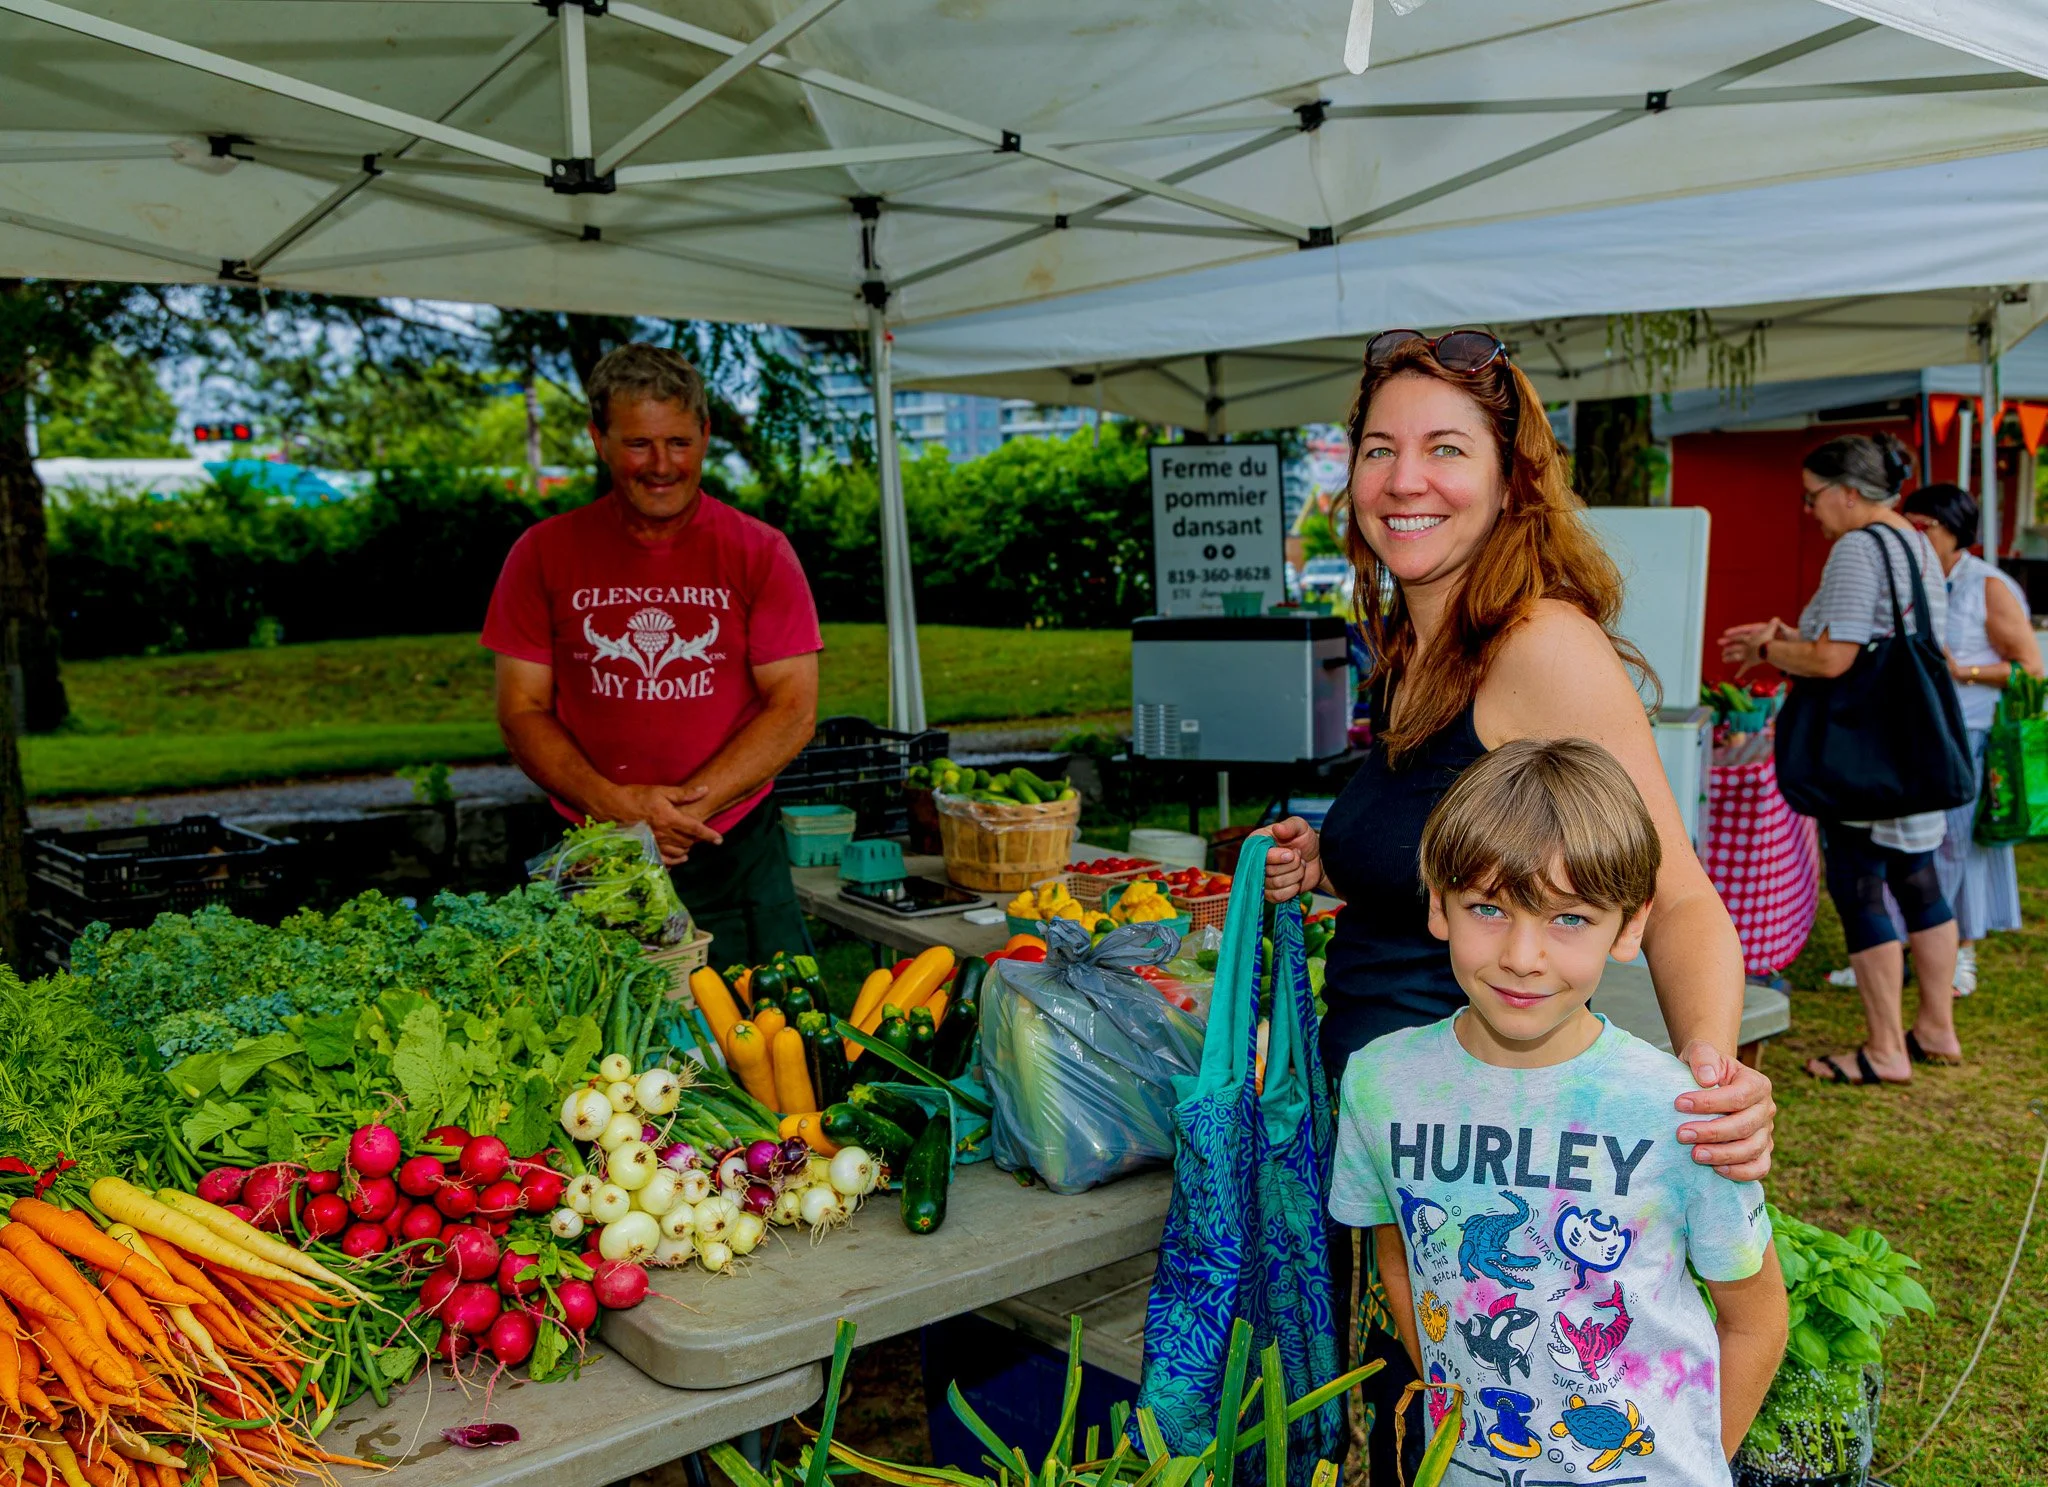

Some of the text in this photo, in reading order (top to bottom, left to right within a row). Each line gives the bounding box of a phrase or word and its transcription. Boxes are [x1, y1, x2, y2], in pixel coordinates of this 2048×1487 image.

[1161, 456, 1267, 479] Ferme du
[1165, 485, 1268, 513] pommier
[1172, 516, 1263, 538] dansant
[1168, 566, 1271, 585] 819-360-8628
[572, 586, 731, 611] GLENGARRY
[590, 666, 715, 701] MY HOME
[1390, 1122, 1655, 1197] HURLEY
[1422, 1238, 1447, 1261] WE RUN
[1524, 1225, 1571, 1271] FINTASTIC
[1431, 1255, 1448, 1270] THIS
[1432, 1270, 1457, 1286] BEACH
[1437, 1349, 1461, 1380] 1999
[1552, 1361, 1630, 1395] SURF AND ENJOY
